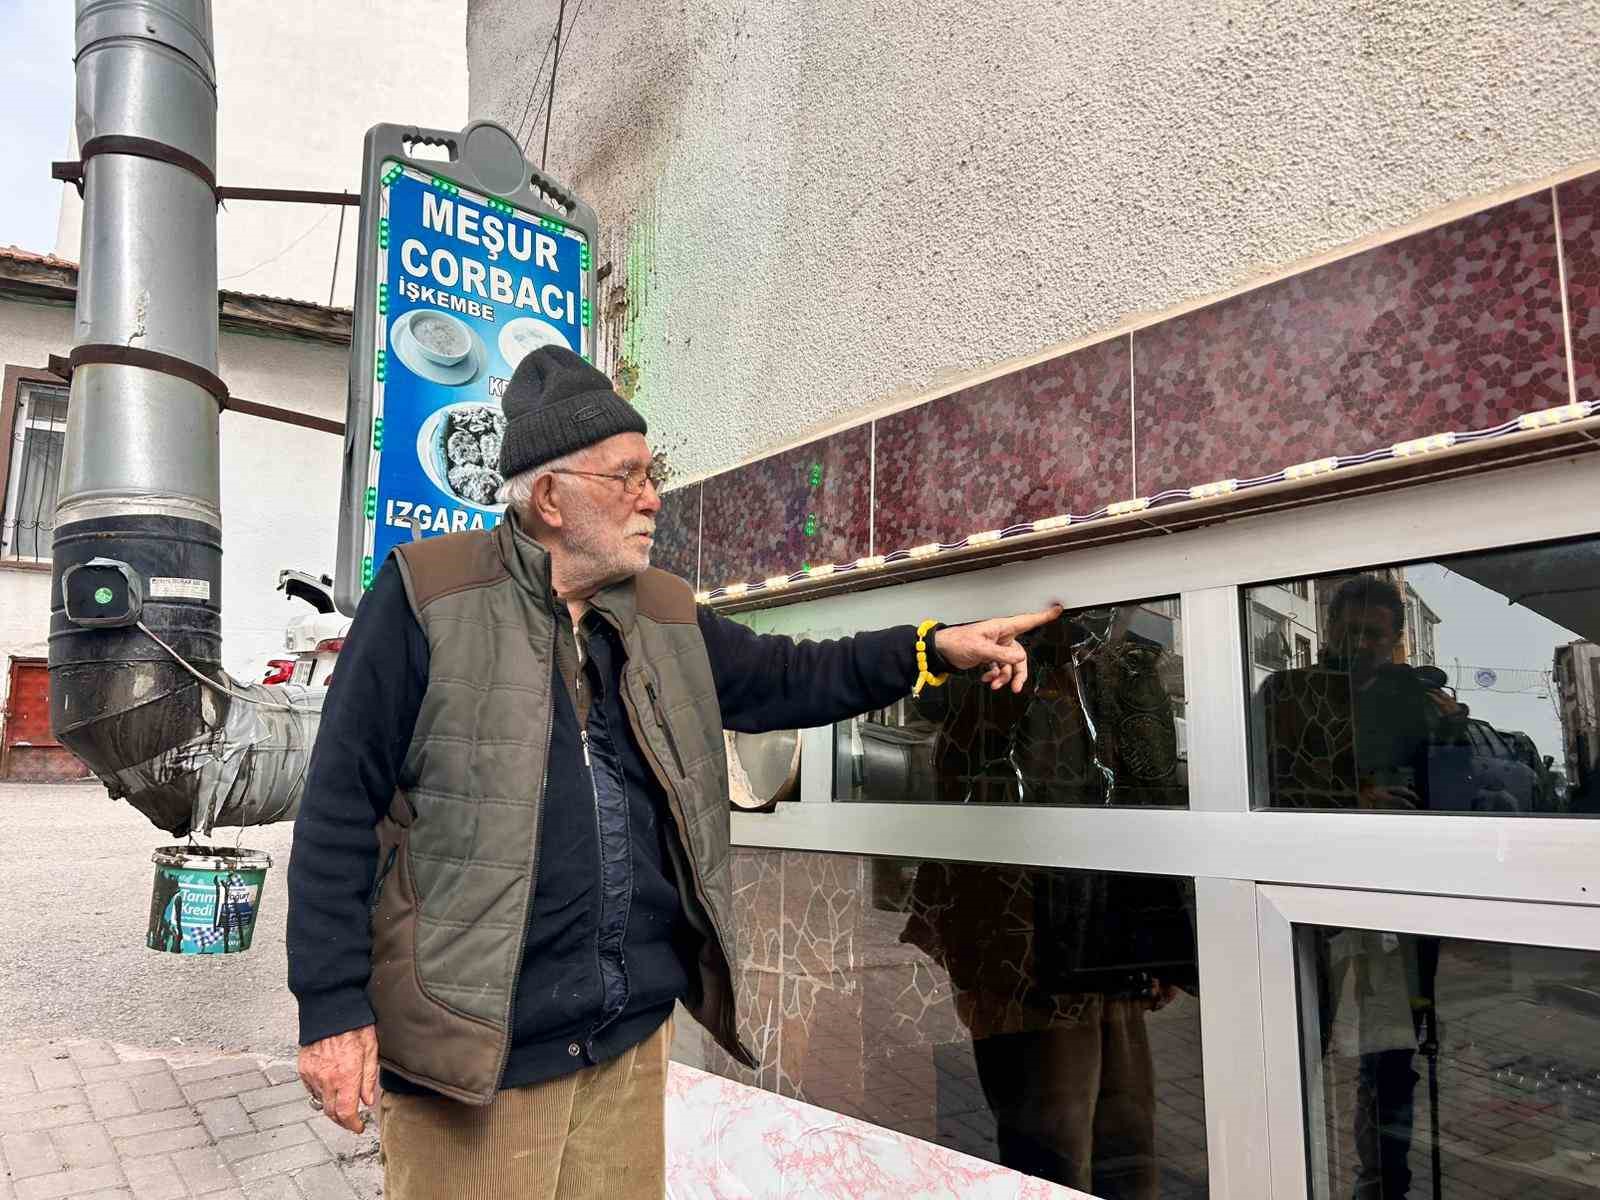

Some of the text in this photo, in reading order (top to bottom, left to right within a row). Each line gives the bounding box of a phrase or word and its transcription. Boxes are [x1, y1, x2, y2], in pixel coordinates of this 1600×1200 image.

[422, 191, 560, 273] MEŞUR
[398, 275, 497, 323] İŞKEMBE
[400, 238, 575, 325] CORBACI
[385, 498, 484, 533] IZGARA
[181, 902, 214, 916] Kredi
